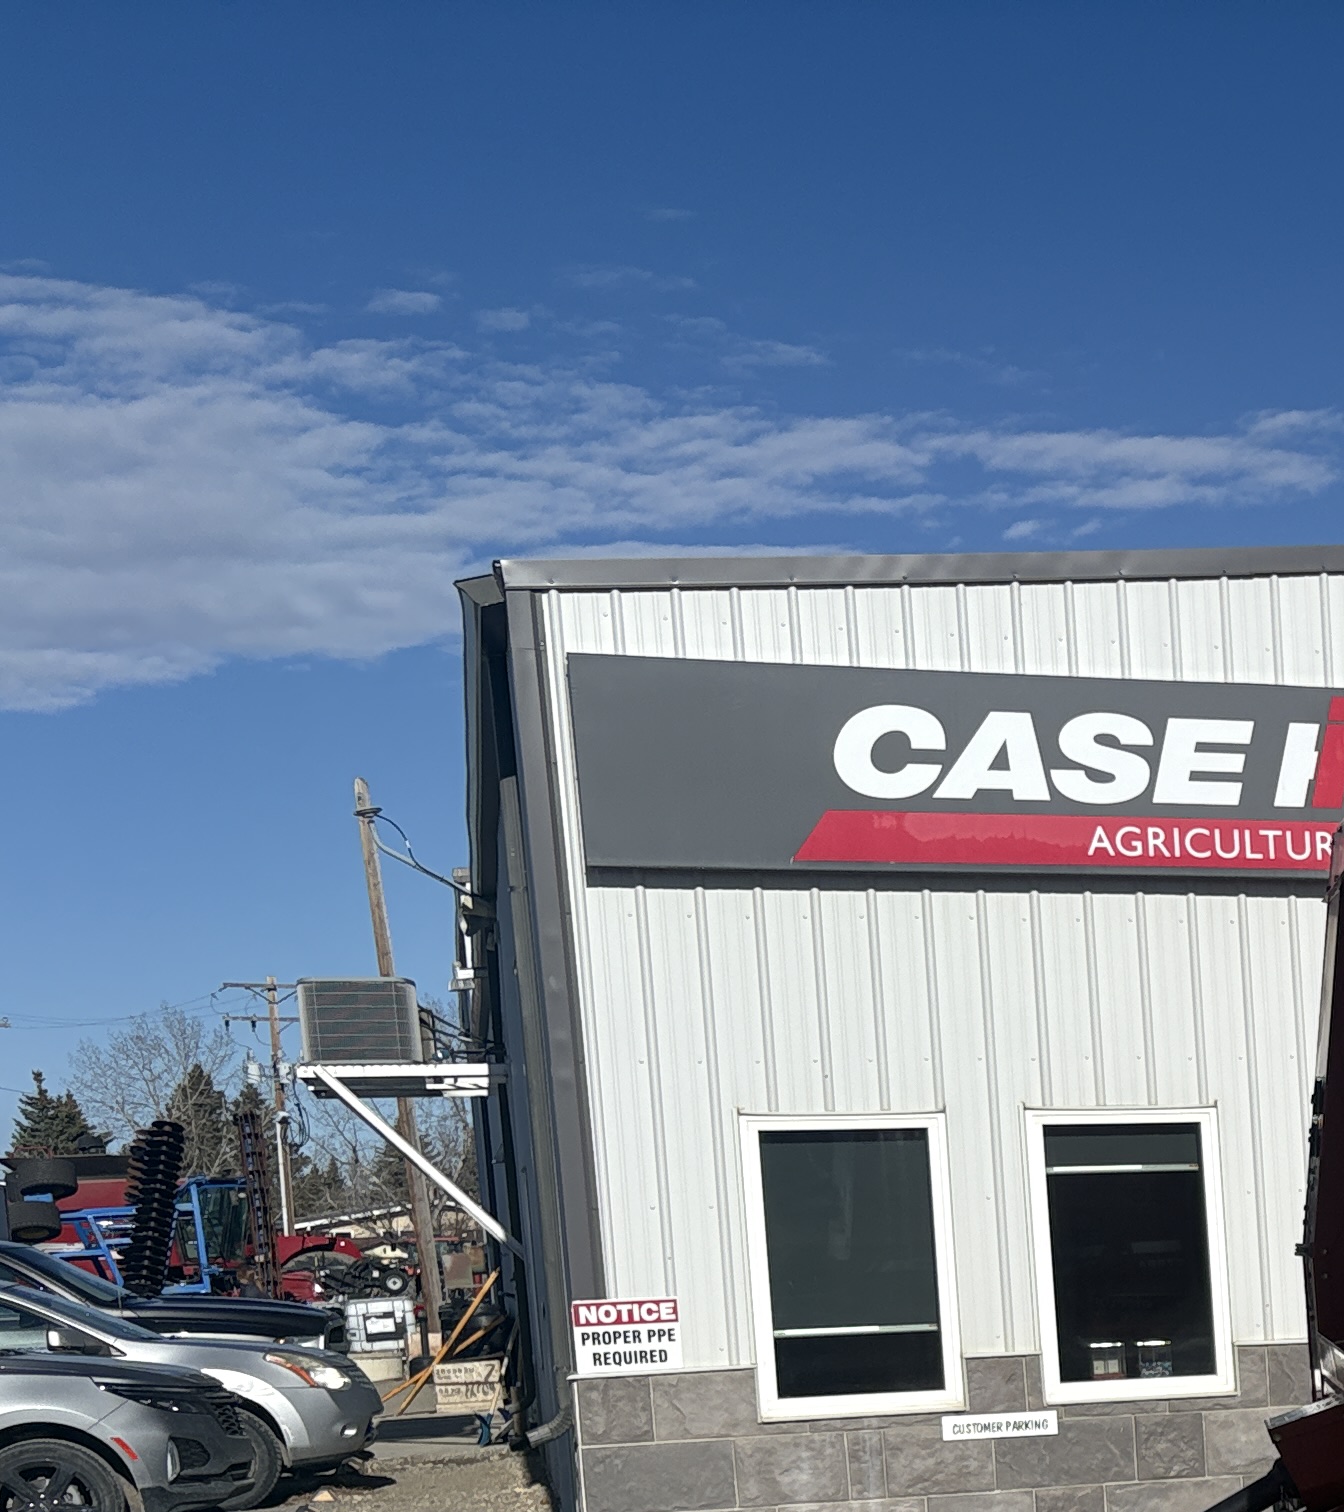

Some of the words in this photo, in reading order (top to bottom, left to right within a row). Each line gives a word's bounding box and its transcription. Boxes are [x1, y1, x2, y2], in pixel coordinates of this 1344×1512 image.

[832, 704, 1255, 806] CASE
[1087, 825, 1332, 861] AGRICULTUR
[578, 1302, 676, 1325] NOTICE
[581, 1329, 642, 1346] PROPER
[647, 1328, 676, 1343] PPE
[592, 1349, 668, 1366] REQUIRED
[952, 1422, 1003, 1435] CUSTOMER
[1005, 1419, 1049, 1432] PARKING
